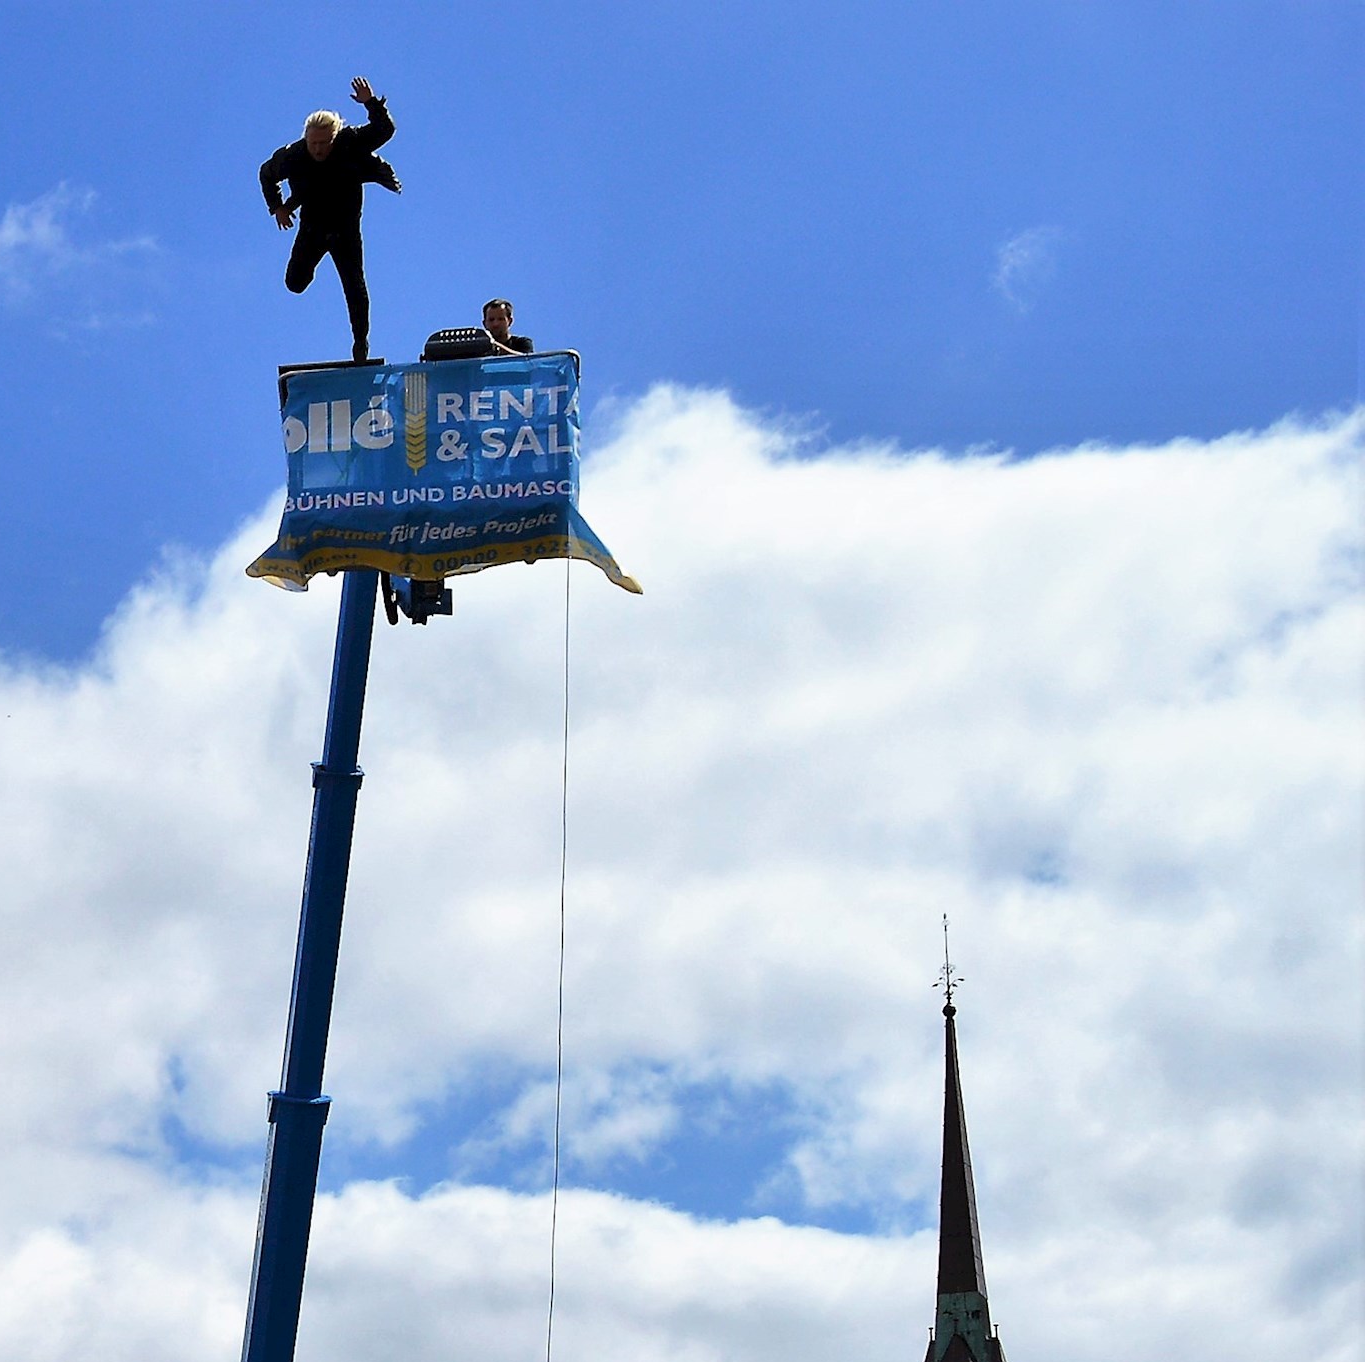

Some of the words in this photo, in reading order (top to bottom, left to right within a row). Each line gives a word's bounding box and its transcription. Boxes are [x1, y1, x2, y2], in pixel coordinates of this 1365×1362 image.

[282, 395, 394, 453] ollé
[436, 429, 469, 462] &
[481, 424, 573, 459] SAL
[392, 487, 445, 505] UND
[452, 480, 572, 501] BAUMASC
[389, 524, 420, 545] für
[420, 522, 477, 544] jedes
[482, 512, 558, 535] Projekt
